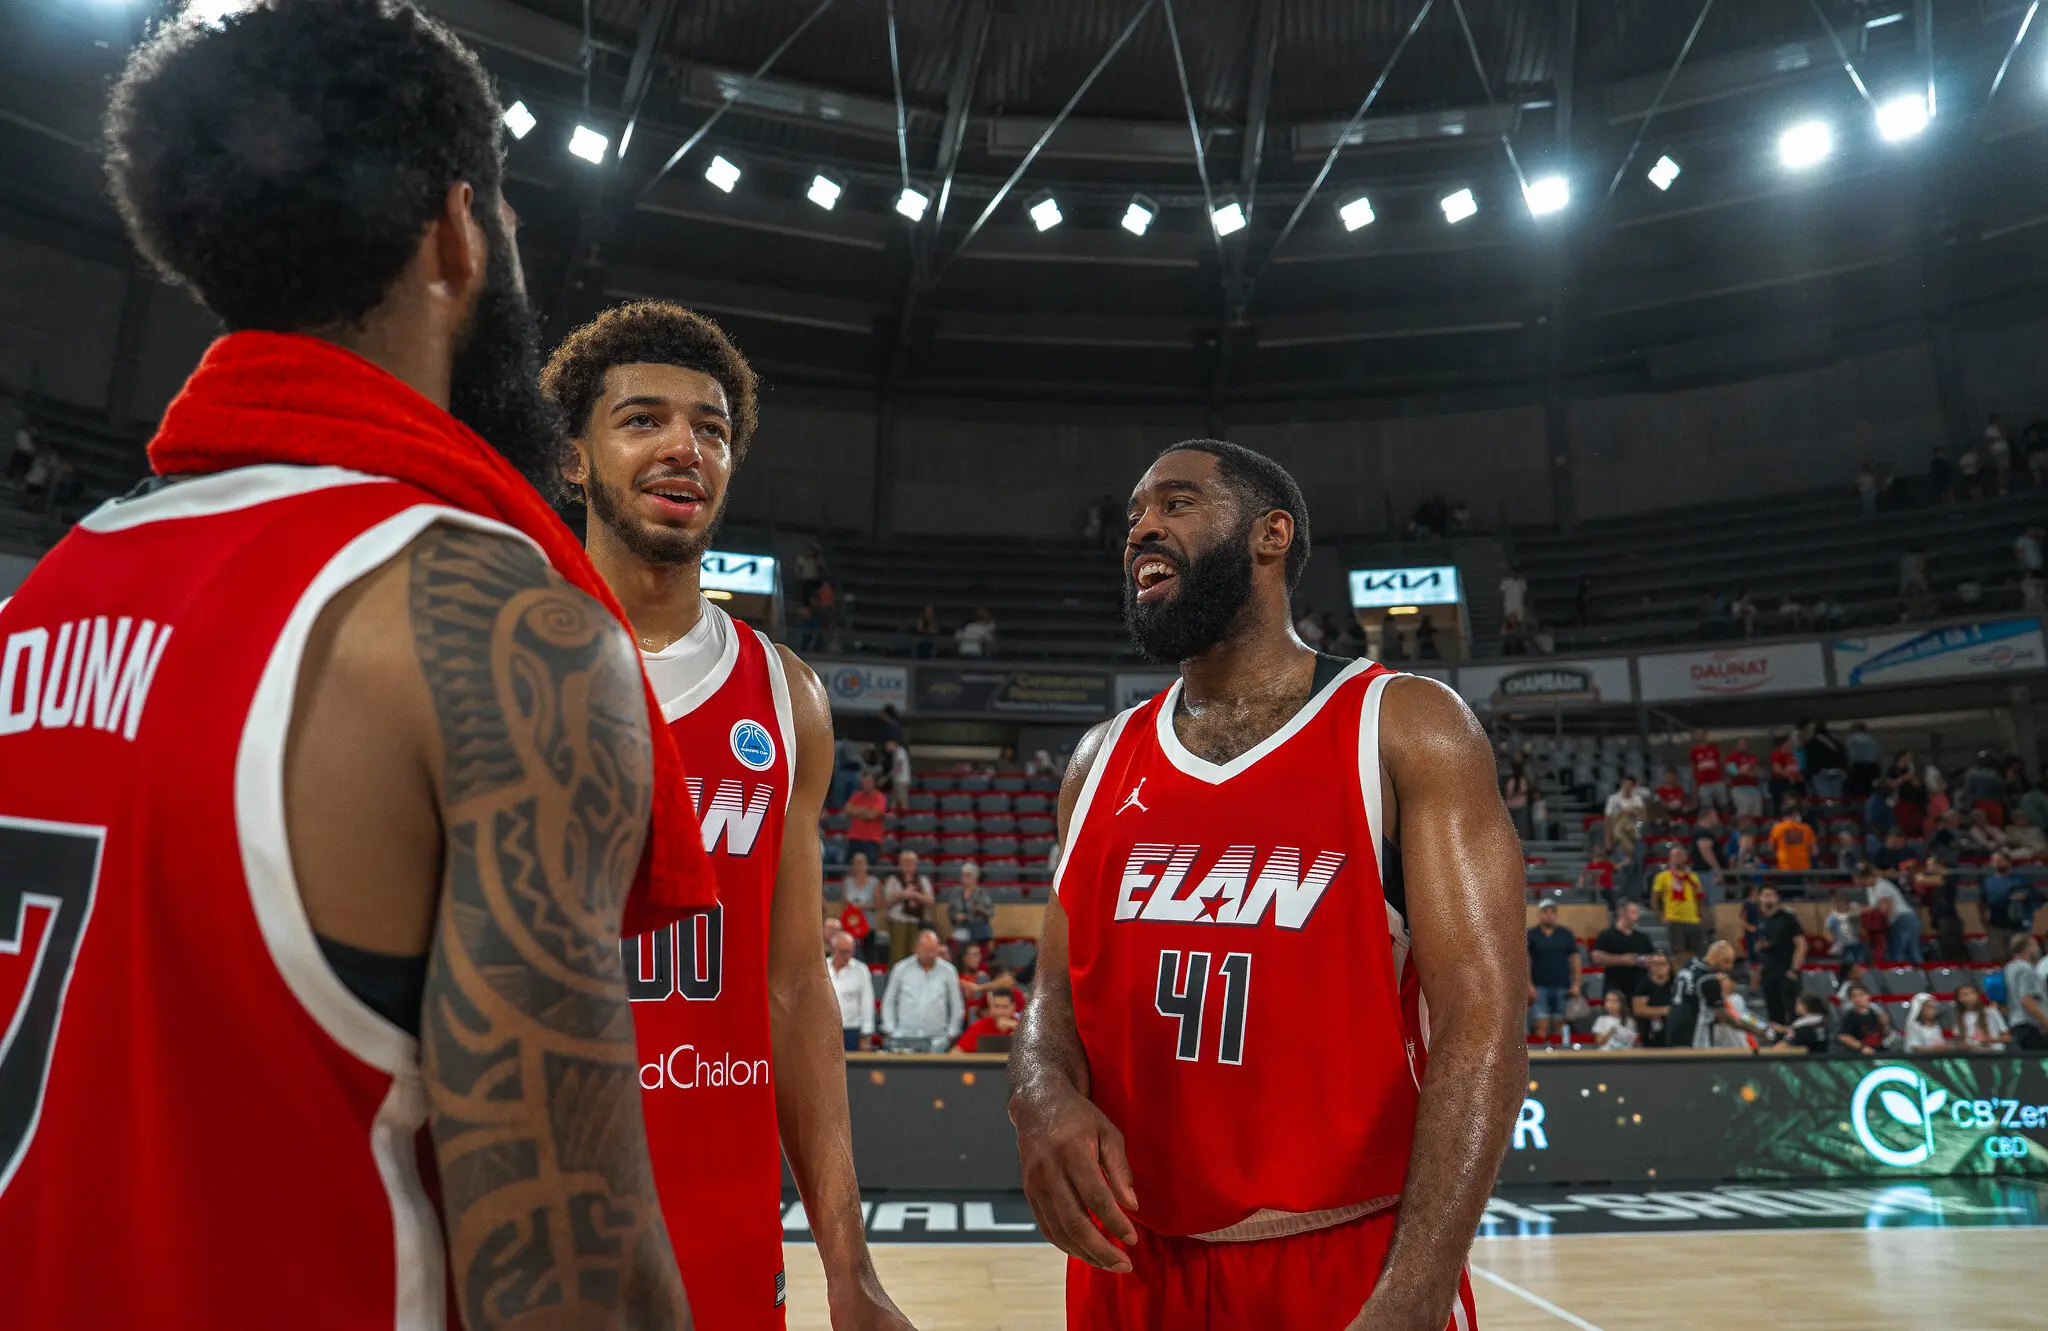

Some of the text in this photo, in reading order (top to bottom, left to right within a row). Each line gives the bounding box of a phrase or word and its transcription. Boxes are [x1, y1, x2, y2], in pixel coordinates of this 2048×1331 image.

[1364, 571, 1440, 591] KIA
[0, 615, 175, 743] DUNN
[1690, 659, 1768, 681] DAUNAT
[1114, 843, 1347, 932] ELAN
[619, 898, 723, 1002] 00
[1154, 949, 1252, 1066] 41
[1984, 1135, 2029, 1159] CBD
